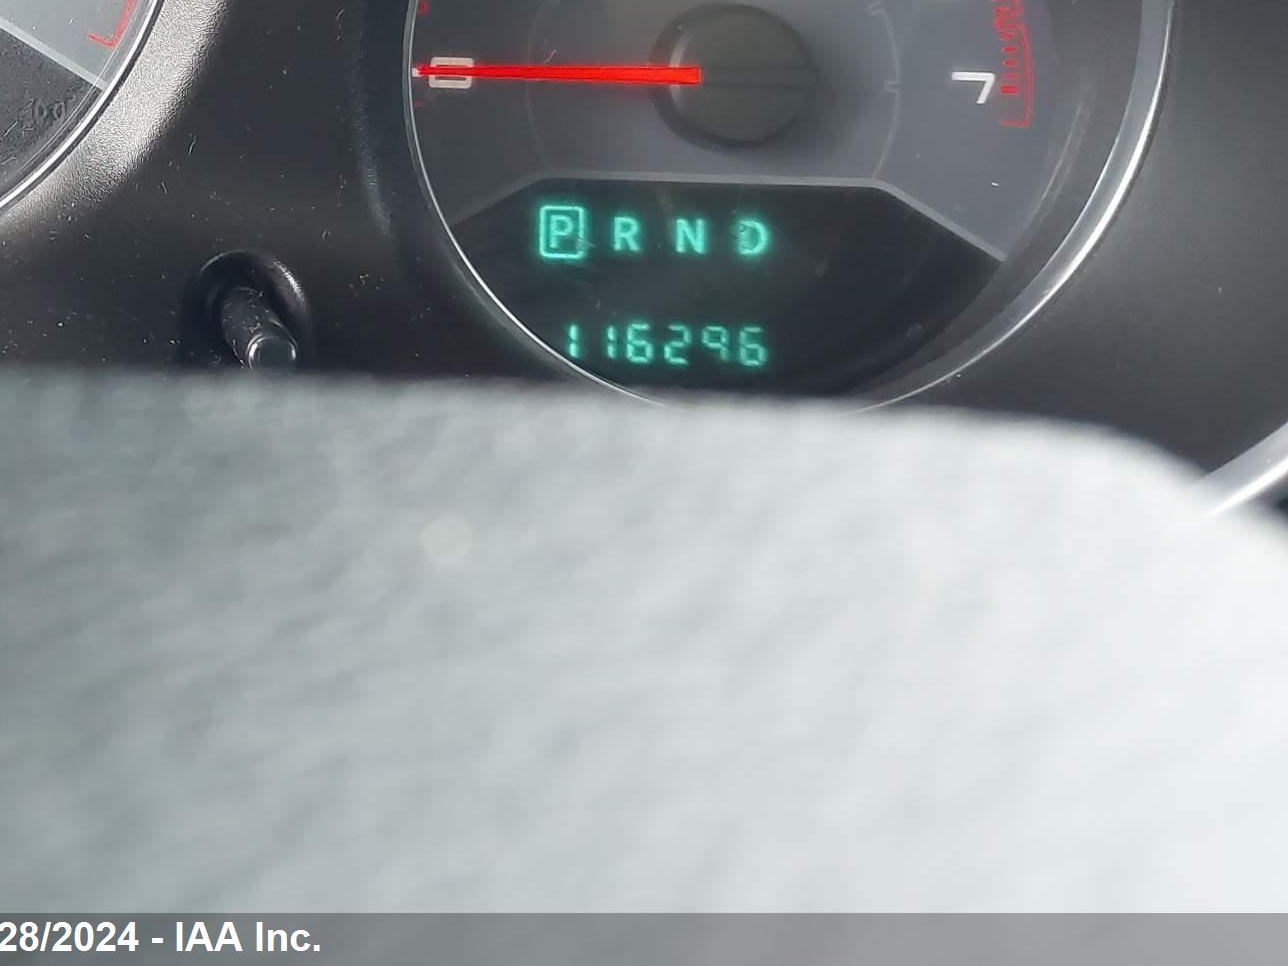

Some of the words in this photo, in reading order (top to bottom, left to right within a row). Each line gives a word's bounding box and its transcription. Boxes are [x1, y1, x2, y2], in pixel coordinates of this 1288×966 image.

[951, 71, 995, 104] 7
[549, 214, 574, 249] P
[613, 216, 641, 252] R
[675, 218, 707, 254] N
[736, 219, 769, 255] D
[568, 323, 767, 366] 116296
